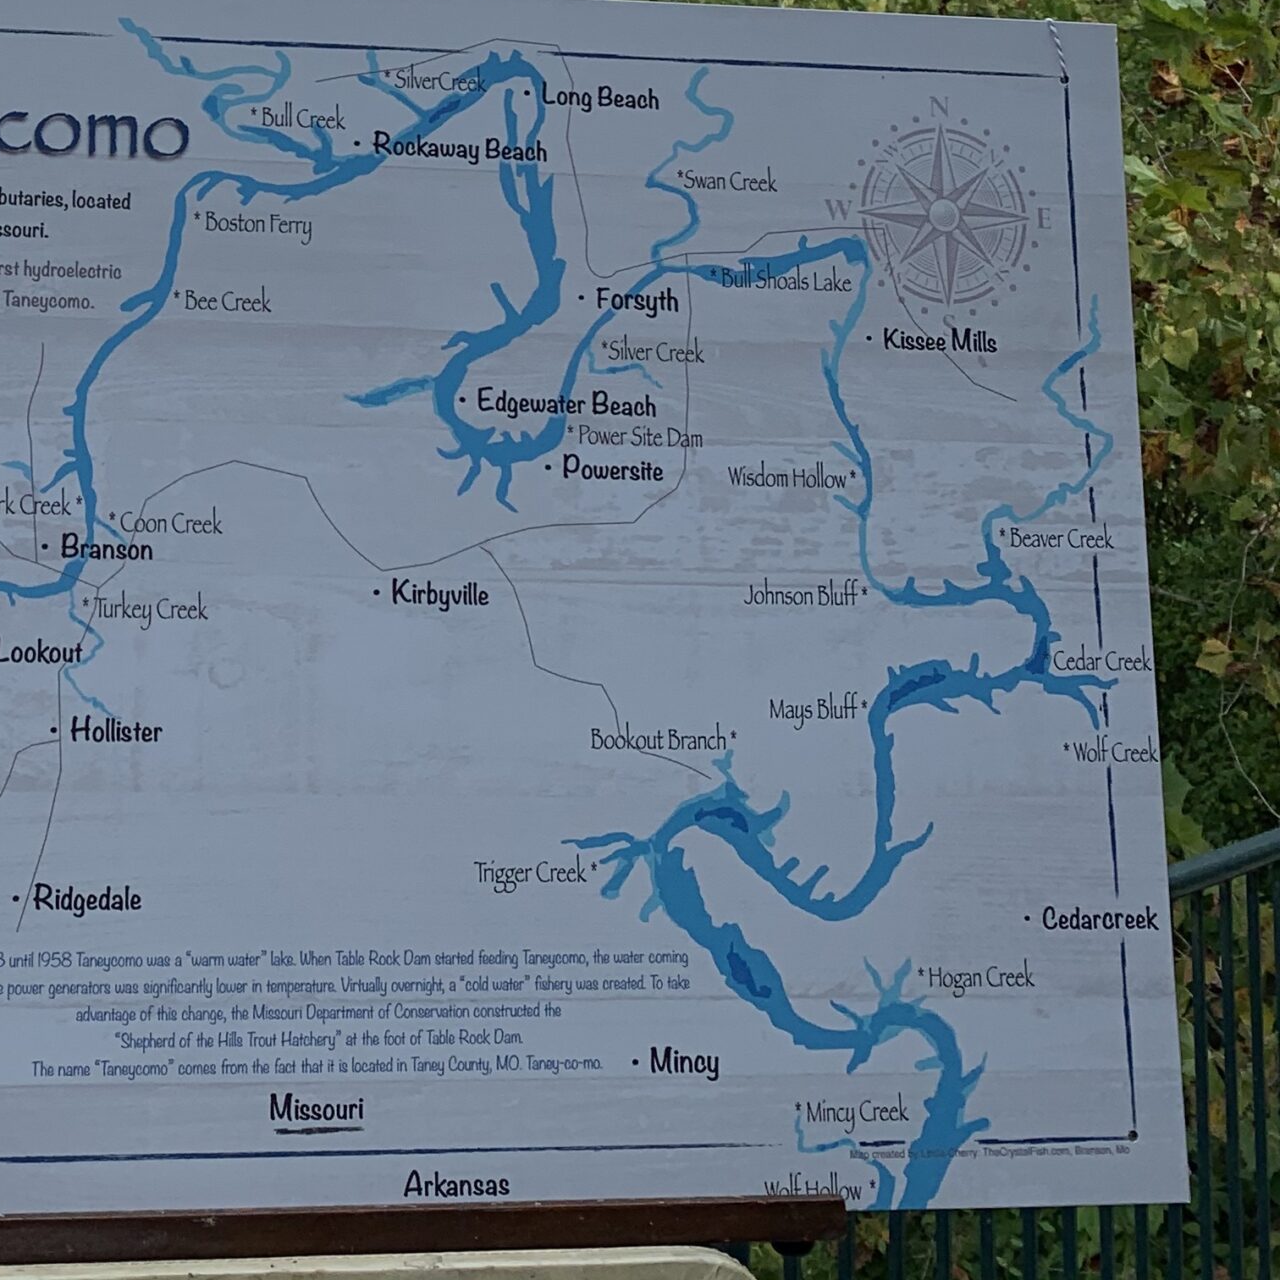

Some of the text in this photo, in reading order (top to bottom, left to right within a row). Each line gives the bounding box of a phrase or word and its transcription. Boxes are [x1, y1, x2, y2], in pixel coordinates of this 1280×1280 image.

[542, 82, 659, 112] Long Beach
[929, 95, 949, 117] N
[262, 102, 346, 131] Bull Creek
[373, 130, 548, 164] Rockaway Beach
[684, 167, 777, 193] Swan Creek
[72, 190, 131, 210] located
[825, 199, 853, 220] W
[205, 211, 312, 246] Boston Ferry
[1035, 207, 1051, 230] E
[721, 266, 751, 288] Bull
[756, 264, 809, 290] Shoals
[814, 266, 852, 293] Lake
[184, 285, 272, 313] Bee Creek
[596, 287, 679, 318] Forsyth
[608, 335, 704, 364] Silver Creek
[883, 327, 998, 353] Kissee Mills
[477, 387, 656, 418] Edgewater Beach
[578, 424, 703, 448] Power Site Dam
[563, 453, 663, 481] Powersite
[728, 461, 846, 489] Wisdom Hollow
[20, 488, 71, 515] Creek
[120, 506, 222, 535] Coon Creek
[61, 532, 153, 560] Branson
[1010, 523, 1115, 550] Beaver Creek
[392, 577, 490, 611] Kirbyville
[744, 578, 860, 607] Johnson Bluff
[94, 590, 208, 631] Turkey Creek
[1053, 644, 1152, 672] Cedar Creek
[770, 692, 860, 730] Mays Bluff
[70, 715, 163, 743] Hollister
[591, 722, 727, 750] Bookout Branch
[1074, 736, 1159, 763] Wolf Creek
[474, 854, 587, 893] Trigger Creek
[33, 883, 142, 917] Ridgedale
[1042, 906, 1159, 931] Cedarcreek
[9, 951, 34, 968] until
[37, 951, 72, 968] 1958
[76, 951, 143, 971] Taneycomo
[147, 956, 171, 967] was
[174, 956, 182, 967] a
[300, 950, 331, 966] When
[335, 950, 364, 966] Table
[369, 950, 401, 966] Rock
[404, 950, 431, 966] Dam
[434, 950, 473, 965] started
[478, 950, 518, 969] feeding
[522, 950, 589, 969] Taneycomo,
[593, 950, 610, 965] the
[613, 951, 645, 965] water
[648, 952, 689, 968] coming
[929, 958, 1035, 998] Hogan Creek
[650, 1047, 719, 1081] Mincy
[269, 1093, 364, 1121] Missouri
[807, 1093, 909, 1134] Mincy Creek
[404, 1169, 510, 1198] Arkansas
[806, 1172, 862, 1201] Hollow
